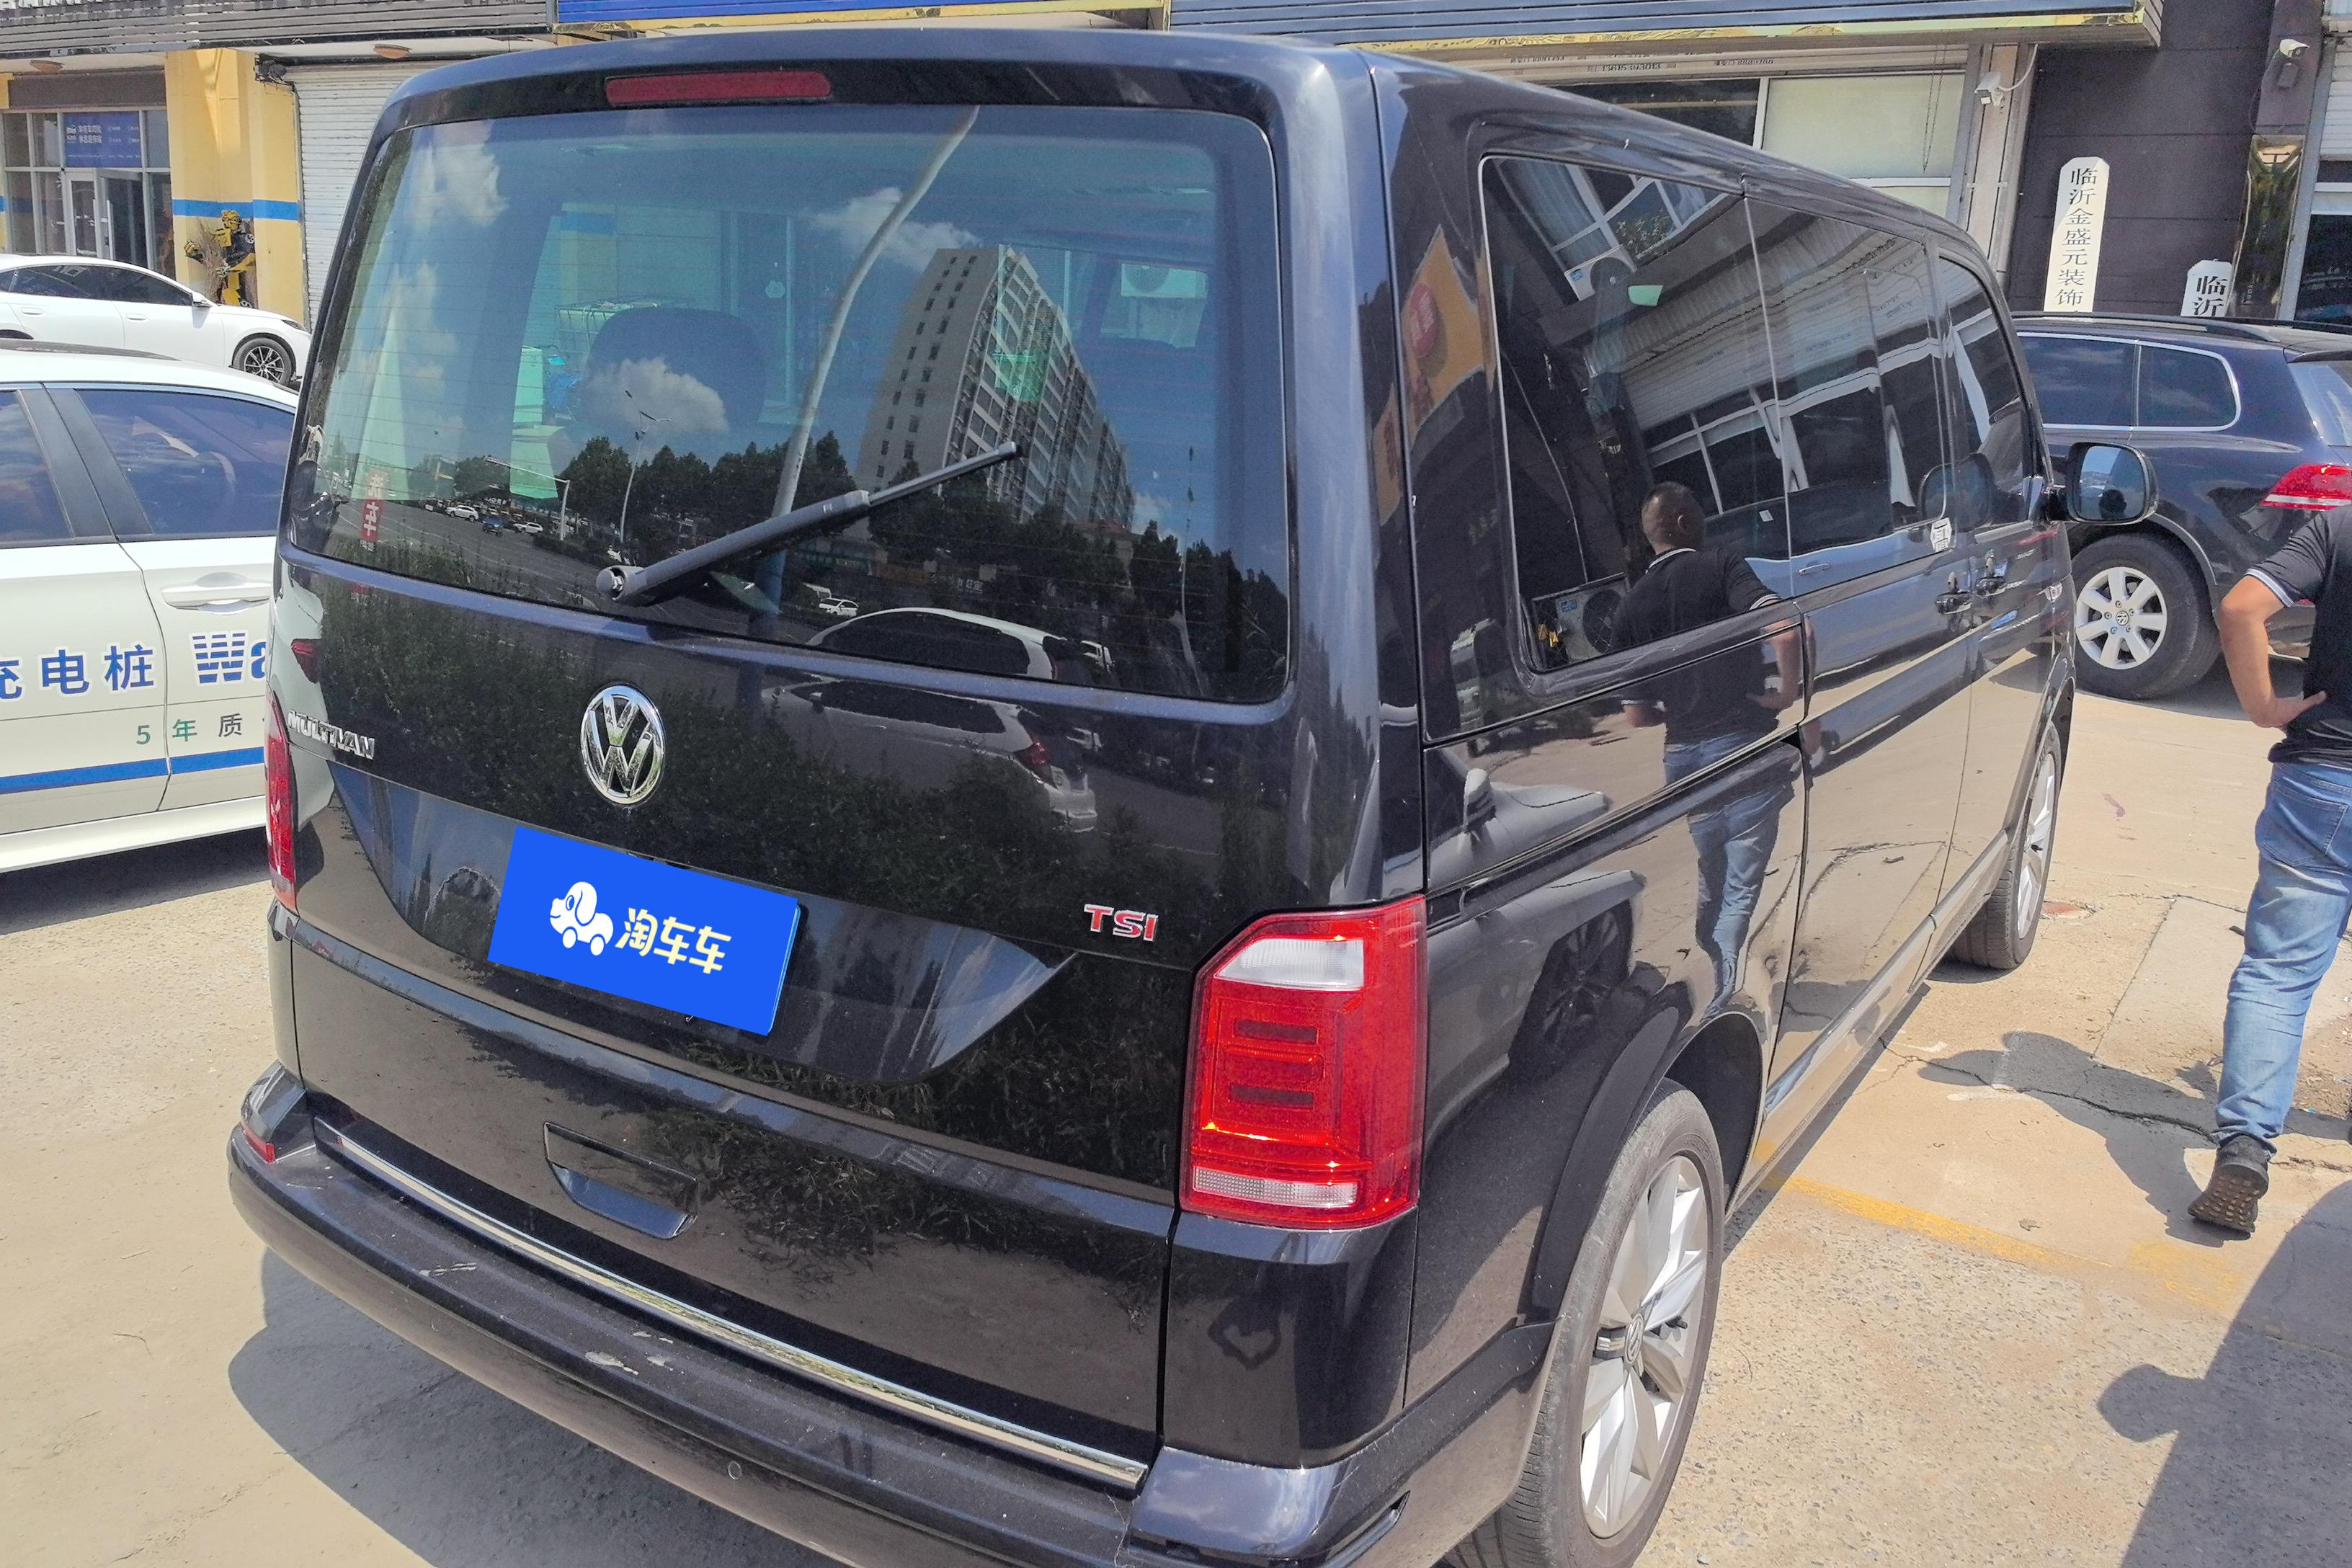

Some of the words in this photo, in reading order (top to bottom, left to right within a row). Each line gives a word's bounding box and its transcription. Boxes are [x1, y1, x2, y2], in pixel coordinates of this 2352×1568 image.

[2054, 168, 2098, 312] 临沂金盛元装饰
[288, 709, 375, 760] MULTIVAN
[1083, 903, 1159, 942] TSI
